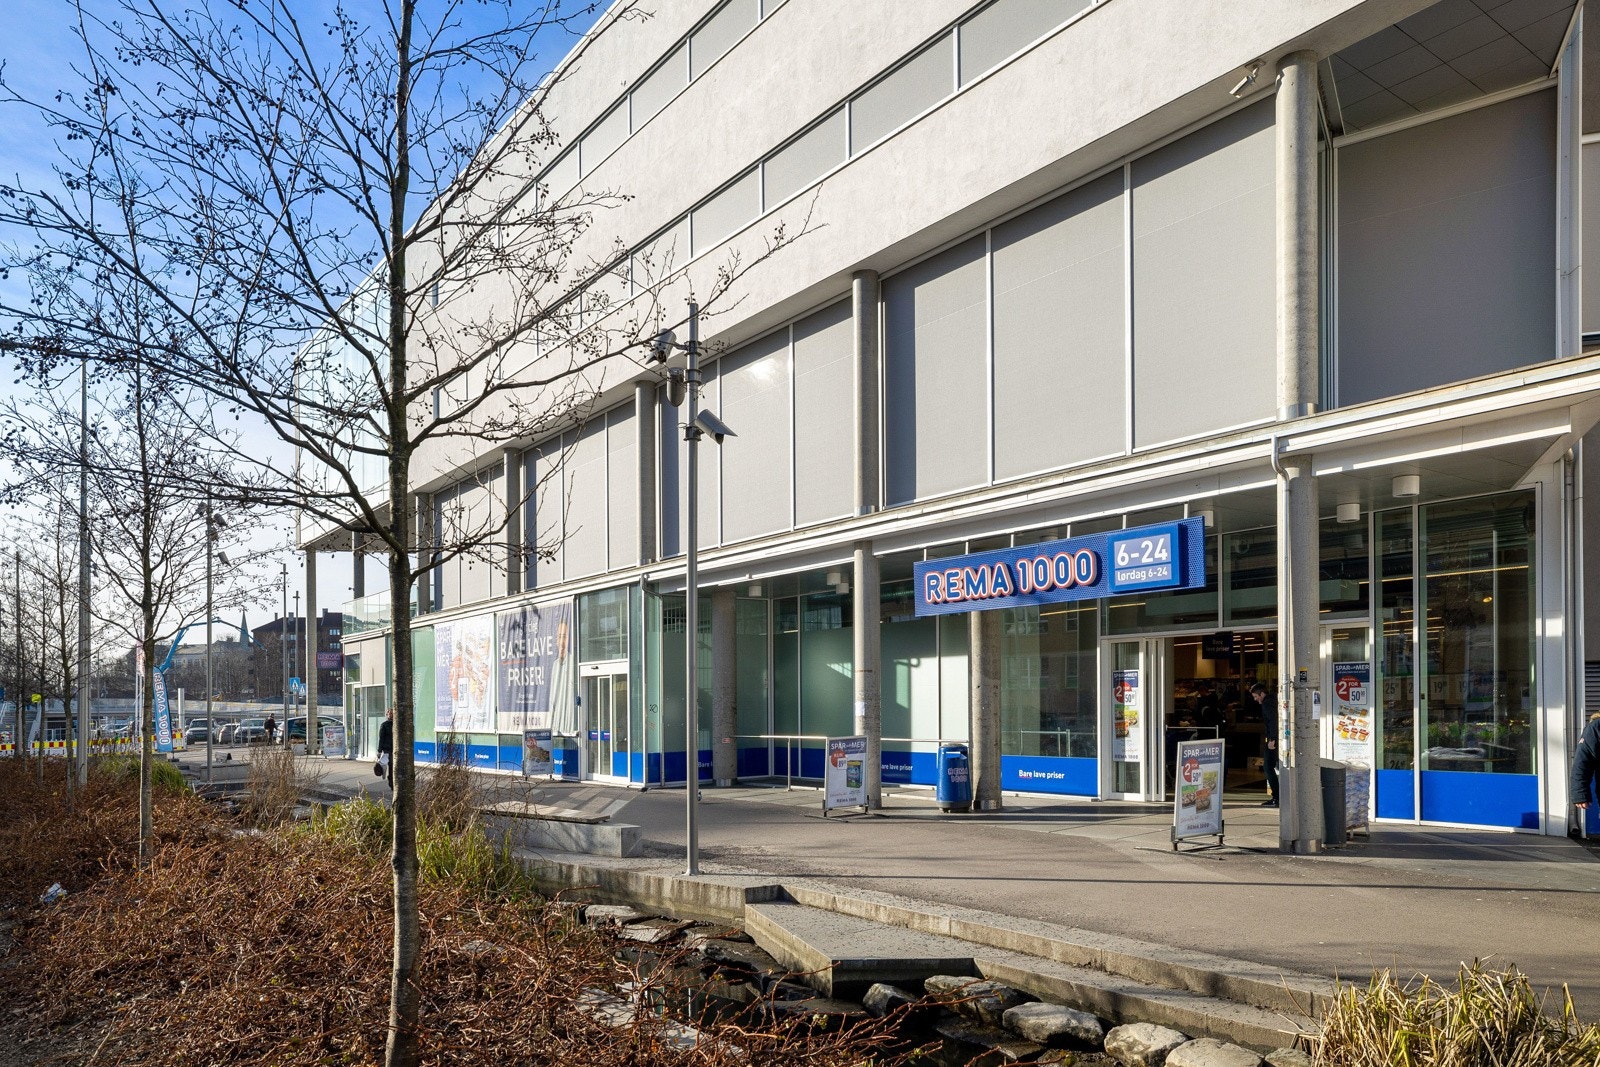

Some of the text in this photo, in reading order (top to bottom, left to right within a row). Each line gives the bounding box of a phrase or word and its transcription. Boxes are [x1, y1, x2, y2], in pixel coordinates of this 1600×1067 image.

[1116, 537, 1169, 567] 6-24
[924, 548, 1098, 604] REMA 1000
[1148, 566, 1168, 578] 6-24
[527, 636, 553, 658] LAVE
[507, 665, 545, 687] PRISER!
[1115, 685, 1123, 697] 2
[1338, 681, 1347, 695] 2
[1385, 682, 1396, 694] 25
[1433, 681, 1443, 693] 19
[1351, 690, 1361, 701] 50
[153, 672, 171, 745] REMA 1000
[831, 740, 846, 750] SPAR
[851, 741, 865, 750] MER
[1183, 748, 1200, 758] SPAR
[1205, 747, 1220, 756] MER
[899, 764, 913, 772] priser
[1184, 763, 1191, 776] 2
[1018, 769, 1065, 780] Bare lave priser
